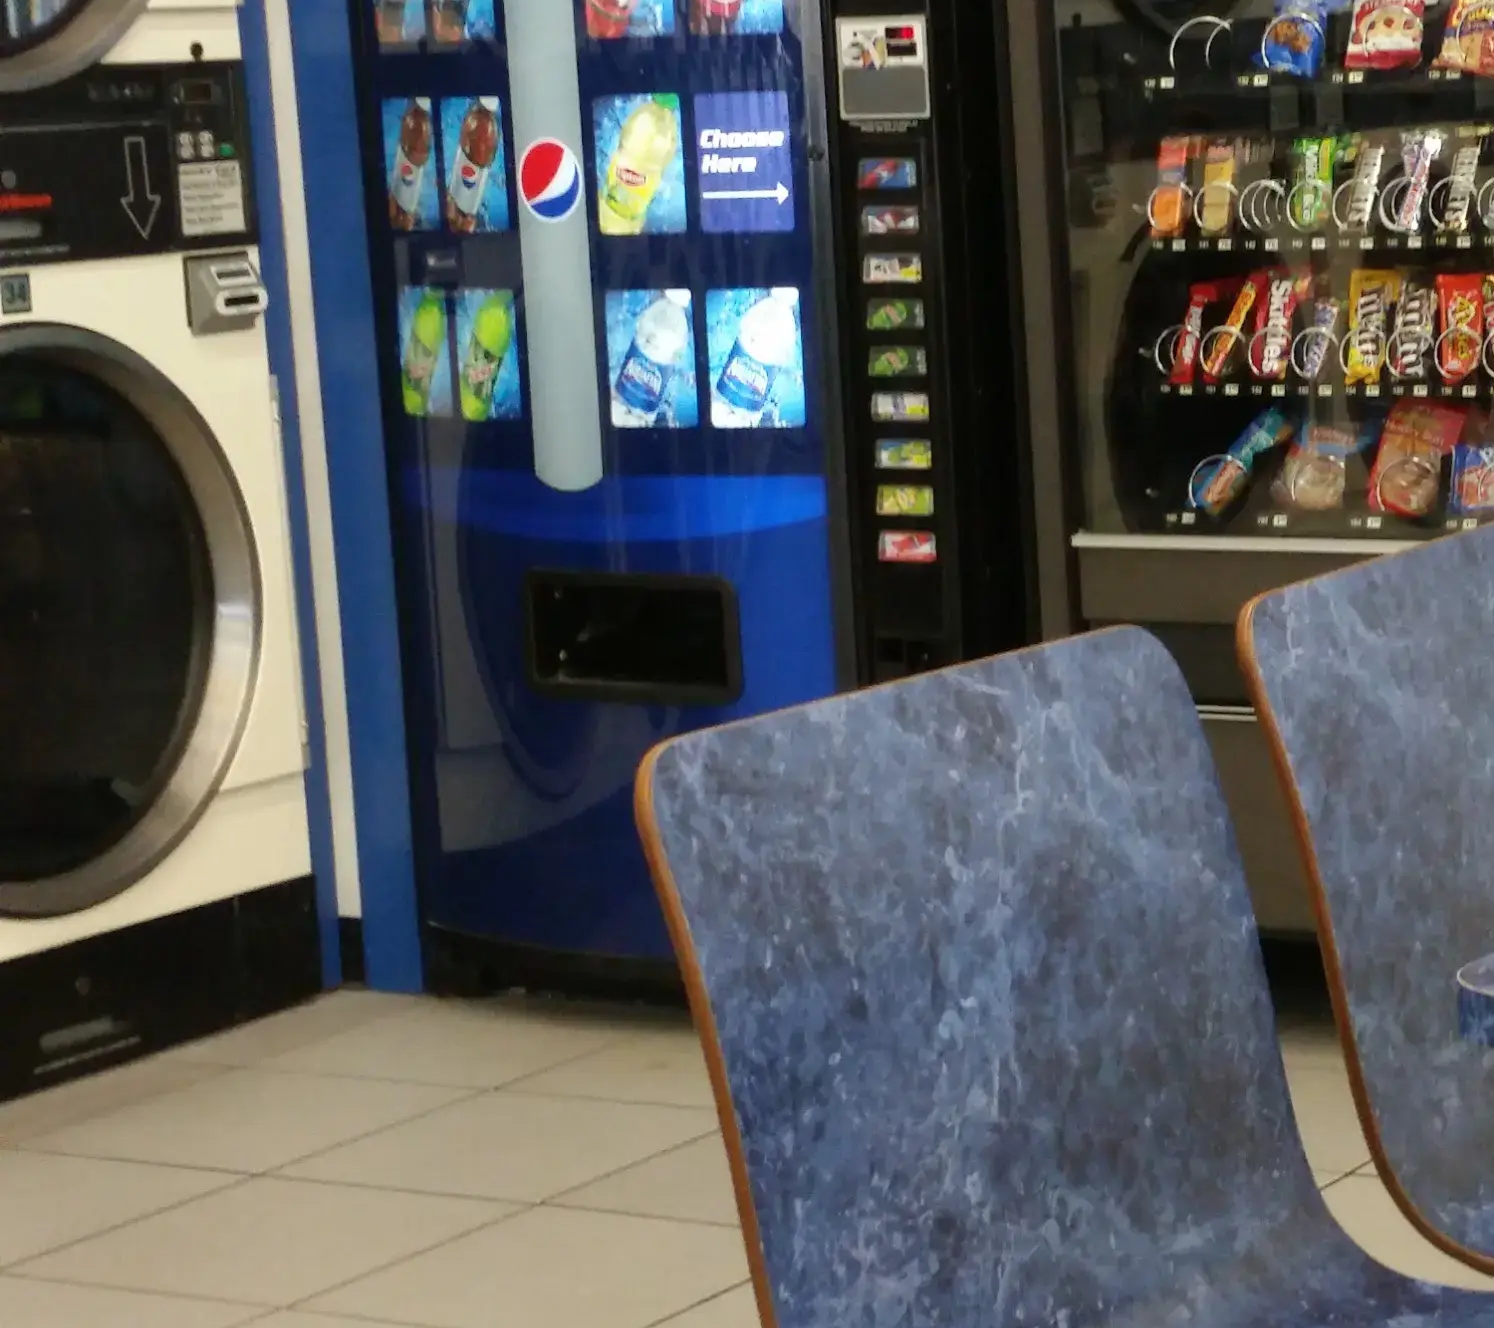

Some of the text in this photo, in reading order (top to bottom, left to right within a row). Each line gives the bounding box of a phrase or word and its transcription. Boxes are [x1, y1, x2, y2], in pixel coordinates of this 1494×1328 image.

[700, 128, 785, 149] Choose
[701, 153, 757, 174] Here
[4, 281, 28, 306] 34
[1261, 279, 1294, 373] Skittles
